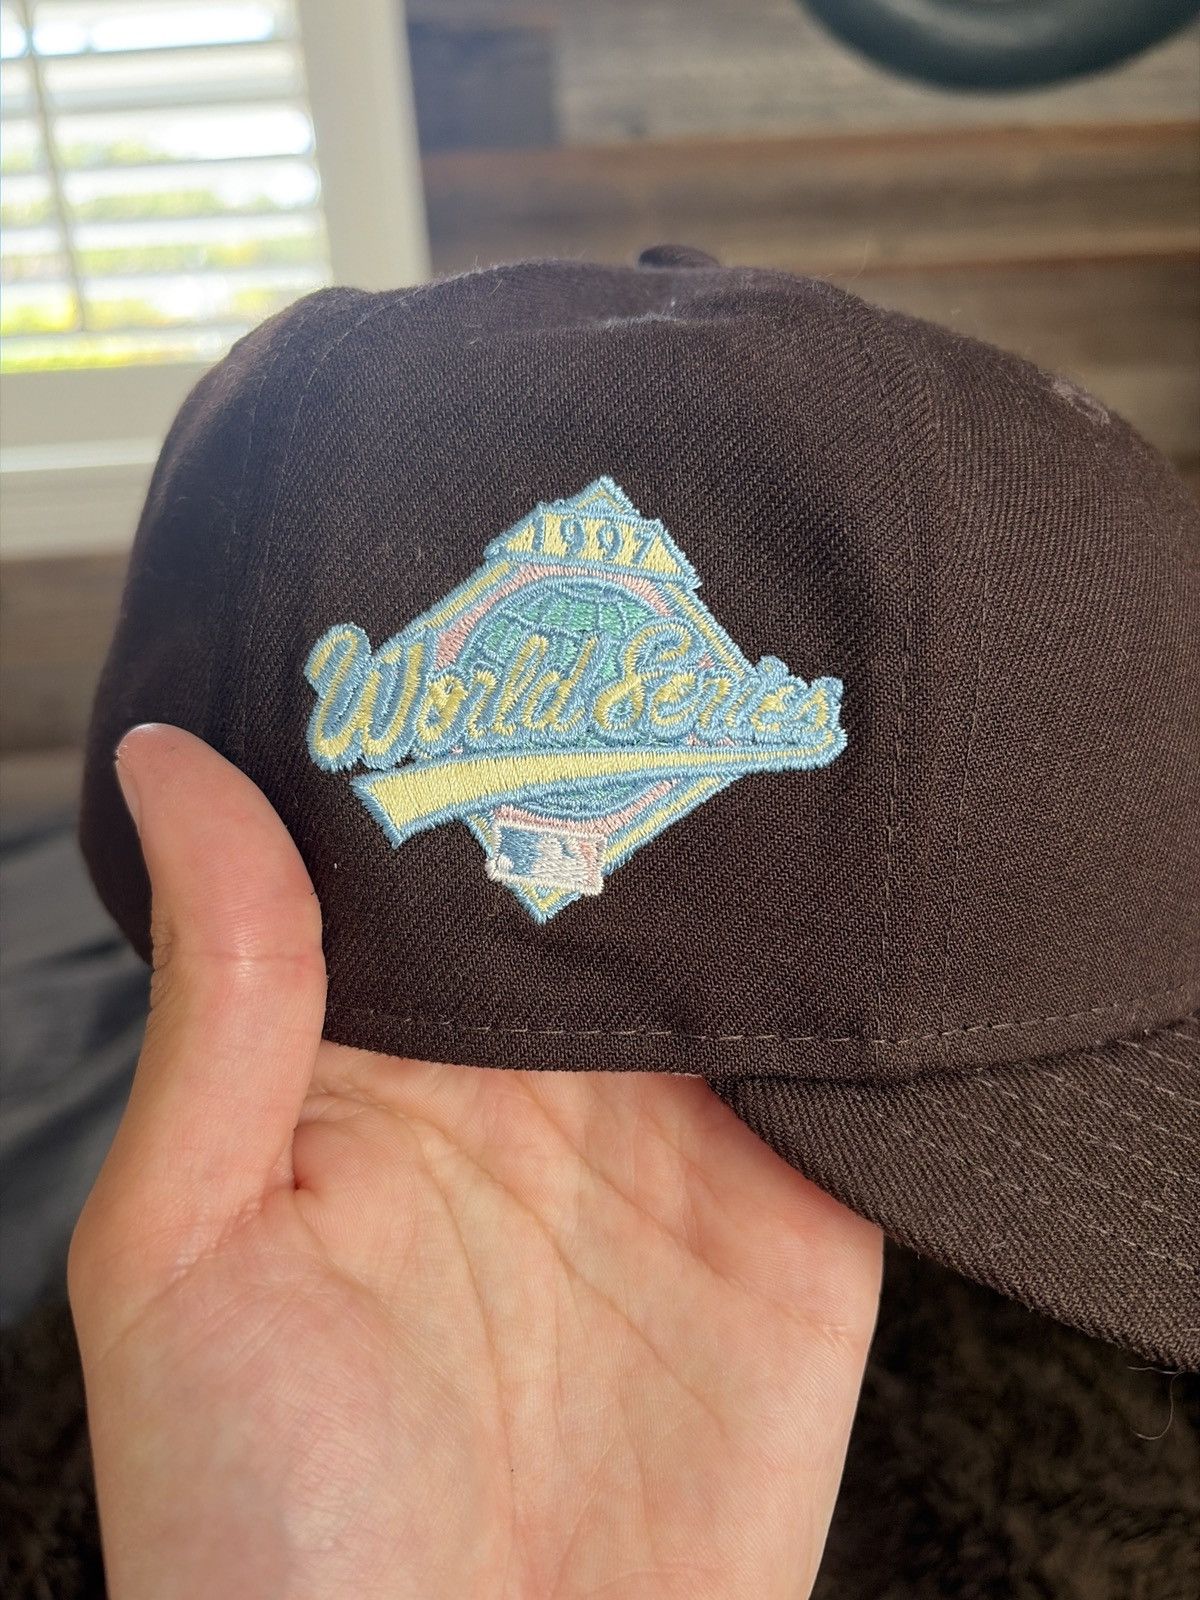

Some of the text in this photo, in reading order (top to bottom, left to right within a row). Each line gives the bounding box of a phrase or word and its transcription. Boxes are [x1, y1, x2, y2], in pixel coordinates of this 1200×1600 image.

[529, 512, 656, 565] 1997
[308, 620, 833, 760] World Series
